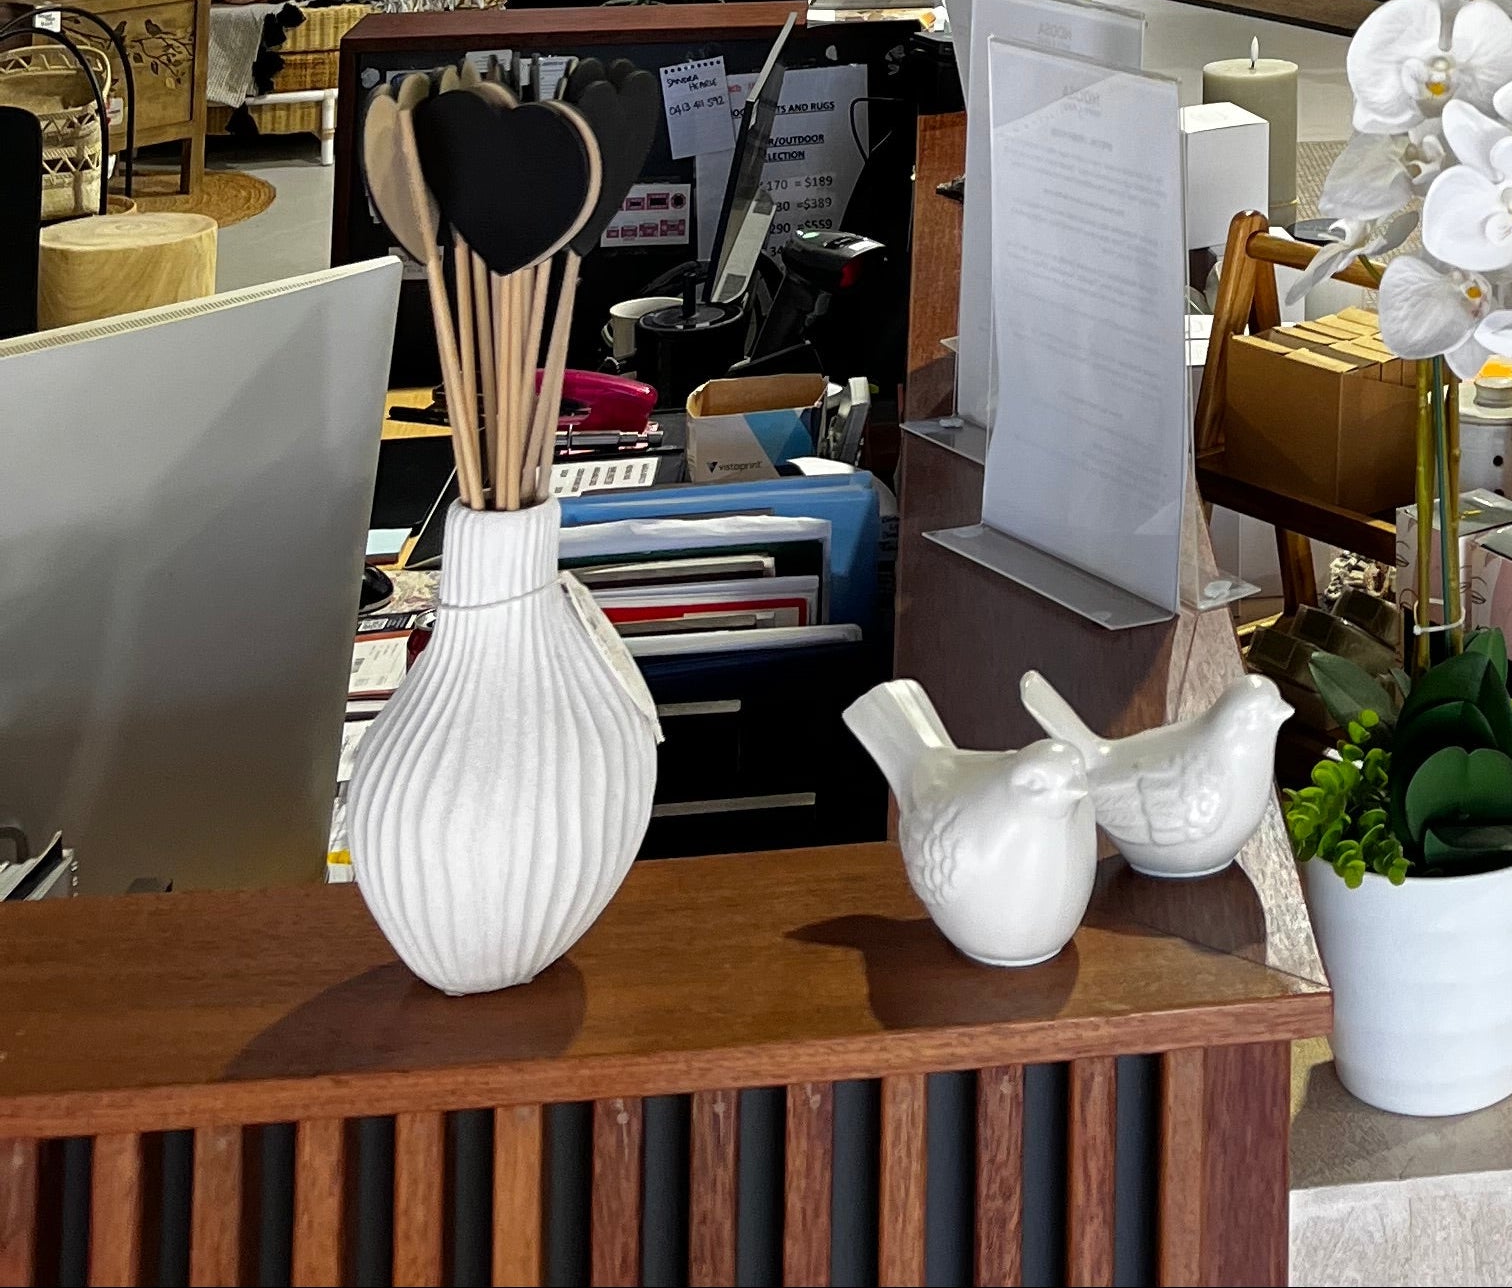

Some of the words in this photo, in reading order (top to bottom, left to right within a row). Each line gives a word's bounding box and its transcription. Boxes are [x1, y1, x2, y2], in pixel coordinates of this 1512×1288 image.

[668, 101, 692, 116] 0413
[706, 95, 726, 108] 592
[788, 103, 809, 114] AND
[810, 101, 836, 112] RUGS
[766, 179, 789, 192] 170
[804, 175, 833, 189] $189
[719, 461, 762, 472] vistaprint
